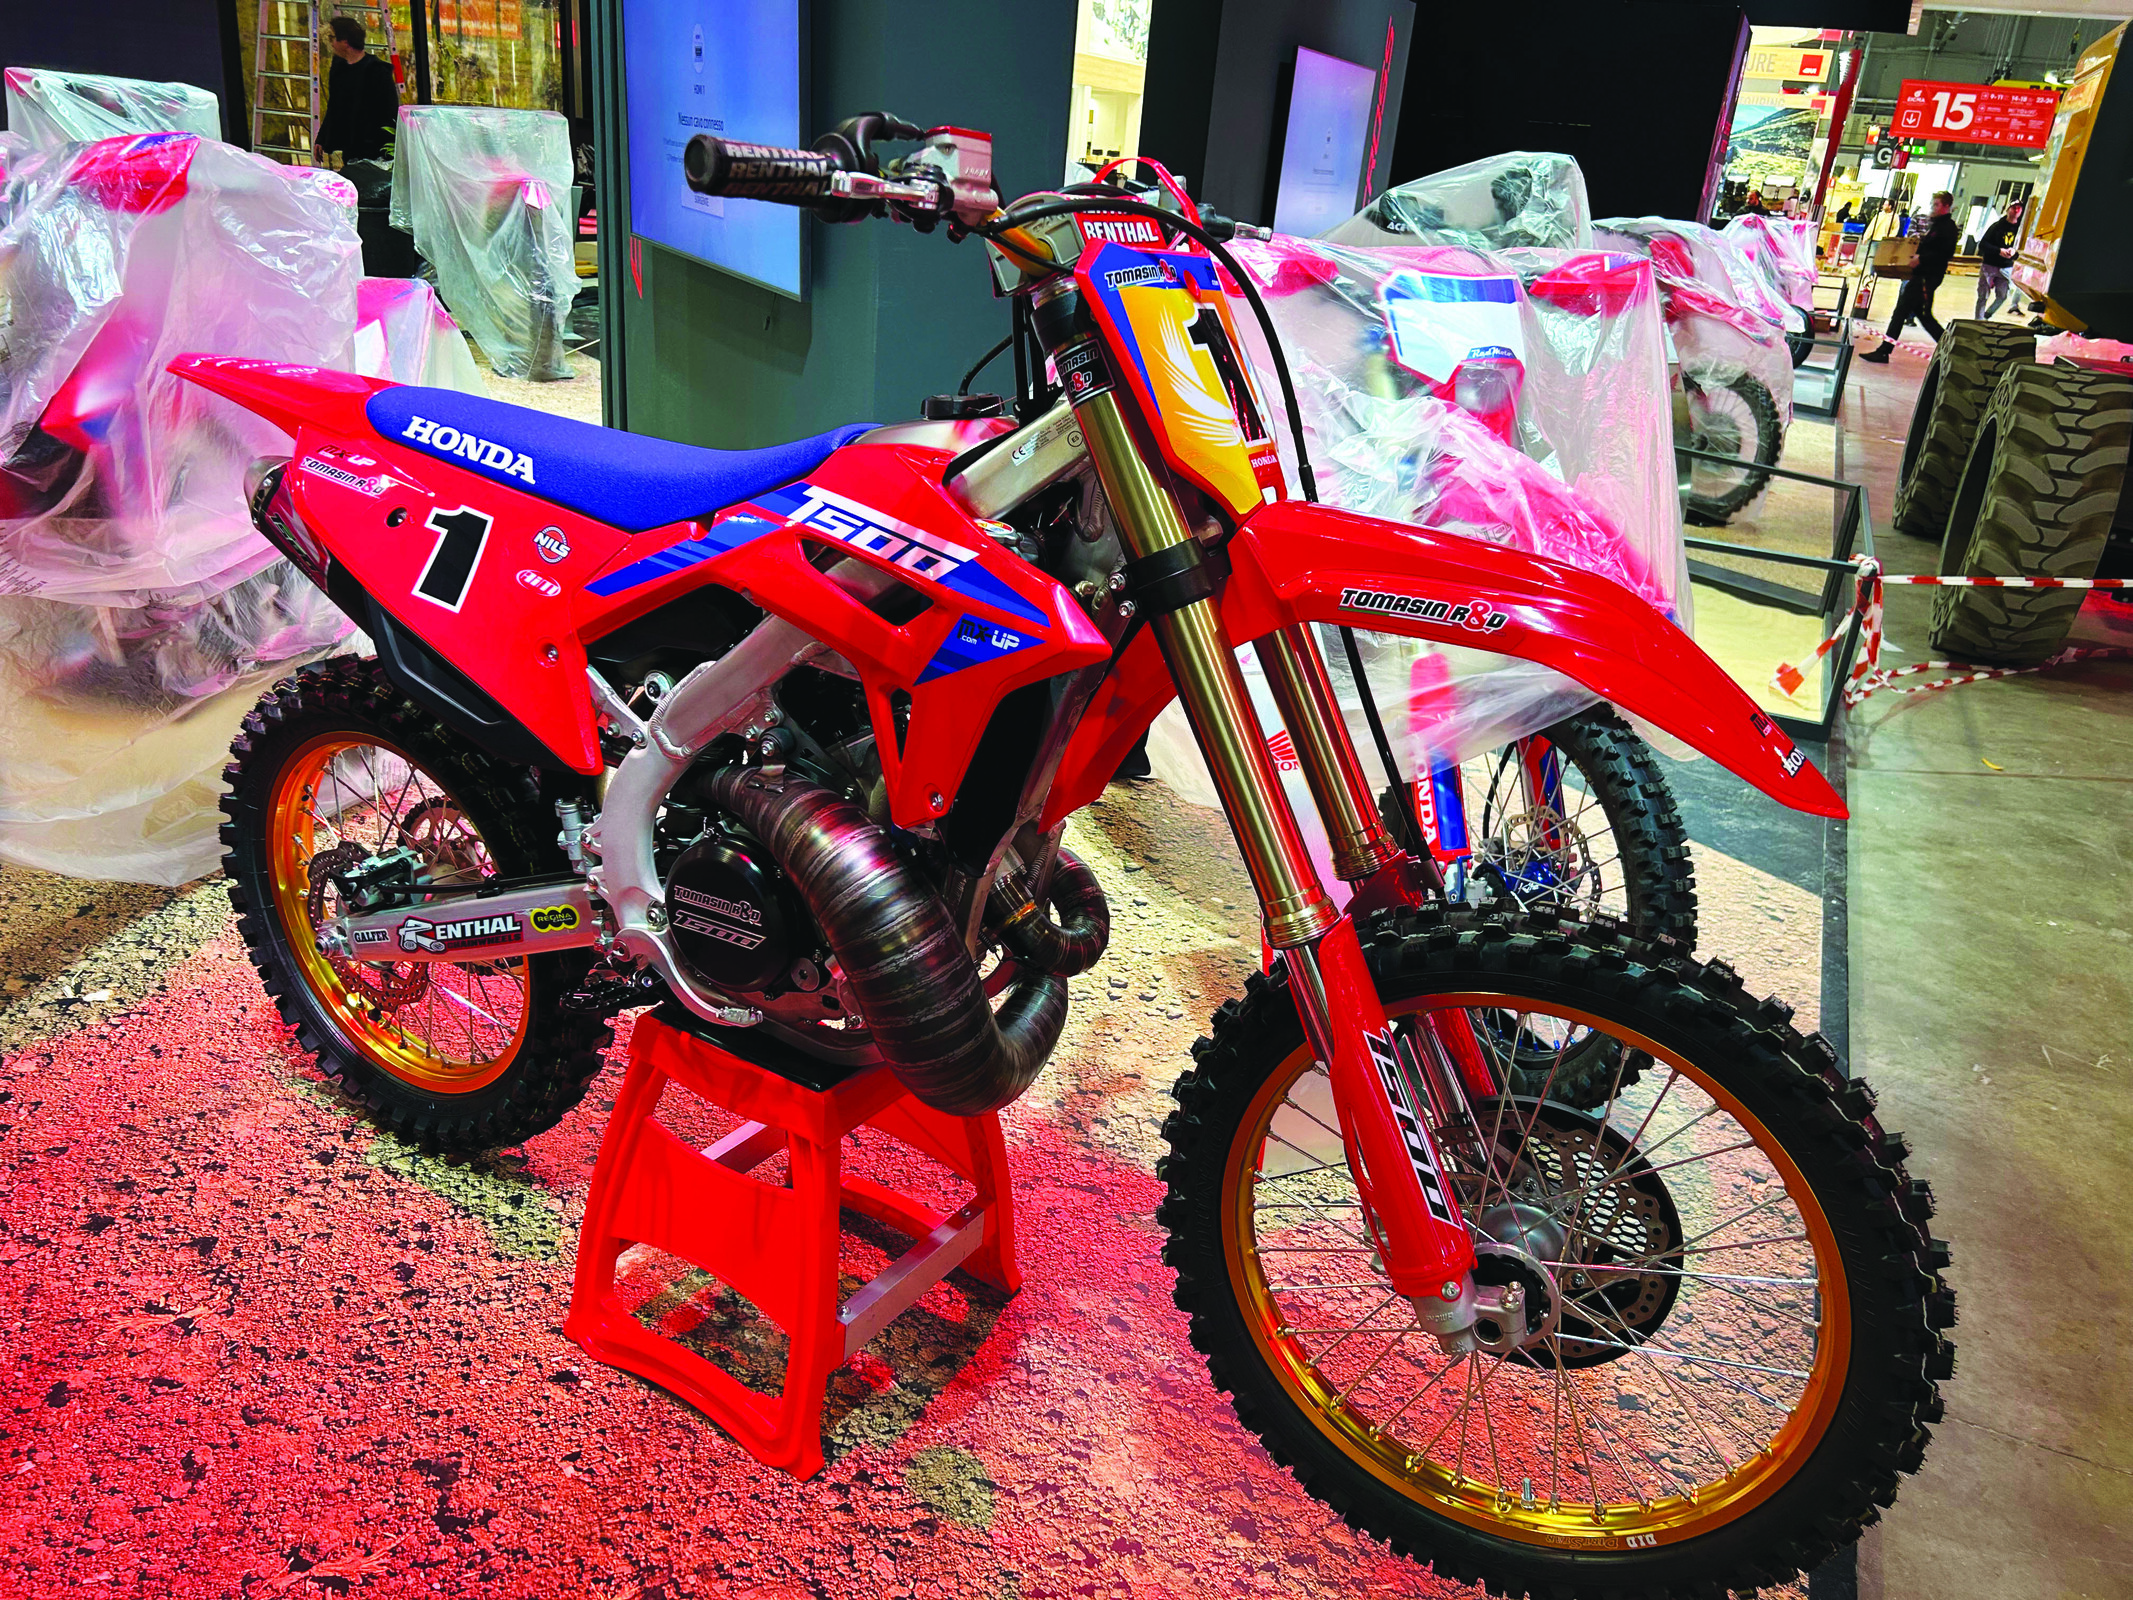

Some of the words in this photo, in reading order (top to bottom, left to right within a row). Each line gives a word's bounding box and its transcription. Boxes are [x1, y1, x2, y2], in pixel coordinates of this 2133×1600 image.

[1932, 91, 1977, 130] 15
[725, 143, 826, 160] RENTHAL
[1877, 147, 1893, 165] G
[729, 160, 832, 179] RENTHAL
[1083, 221, 1159, 243] RENTHAL
[1105, 265, 1158, 287] TOMASIN
[1158, 259, 1177, 282] R&D
[1058, 347, 1099, 376] OMASIN
[1183, 303, 1270, 447] 1
[402, 416, 536, 485] HONDA
[1250, 454, 1278, 468] HONDA
[300, 456, 355, 485] TOMASIN
[411, 504, 494, 614] 1
[533, 531, 571, 559] NILS
[1341, 588, 1451, 620] TOMASIN
[1449, 600, 1510, 633] R&D
[959, 619, 1020, 650] MX-UP
[1414, 760, 1437, 847] ONDA
[537, 912, 572, 923] REGINA
[674, 885, 731, 912] TOMASIN
[731, 901, 762, 923] R&D
[354, 930, 389, 943] GALFER
[398, 916, 521, 953] RENTHAL
[447, 934, 522, 950] CHAINWHEELS
